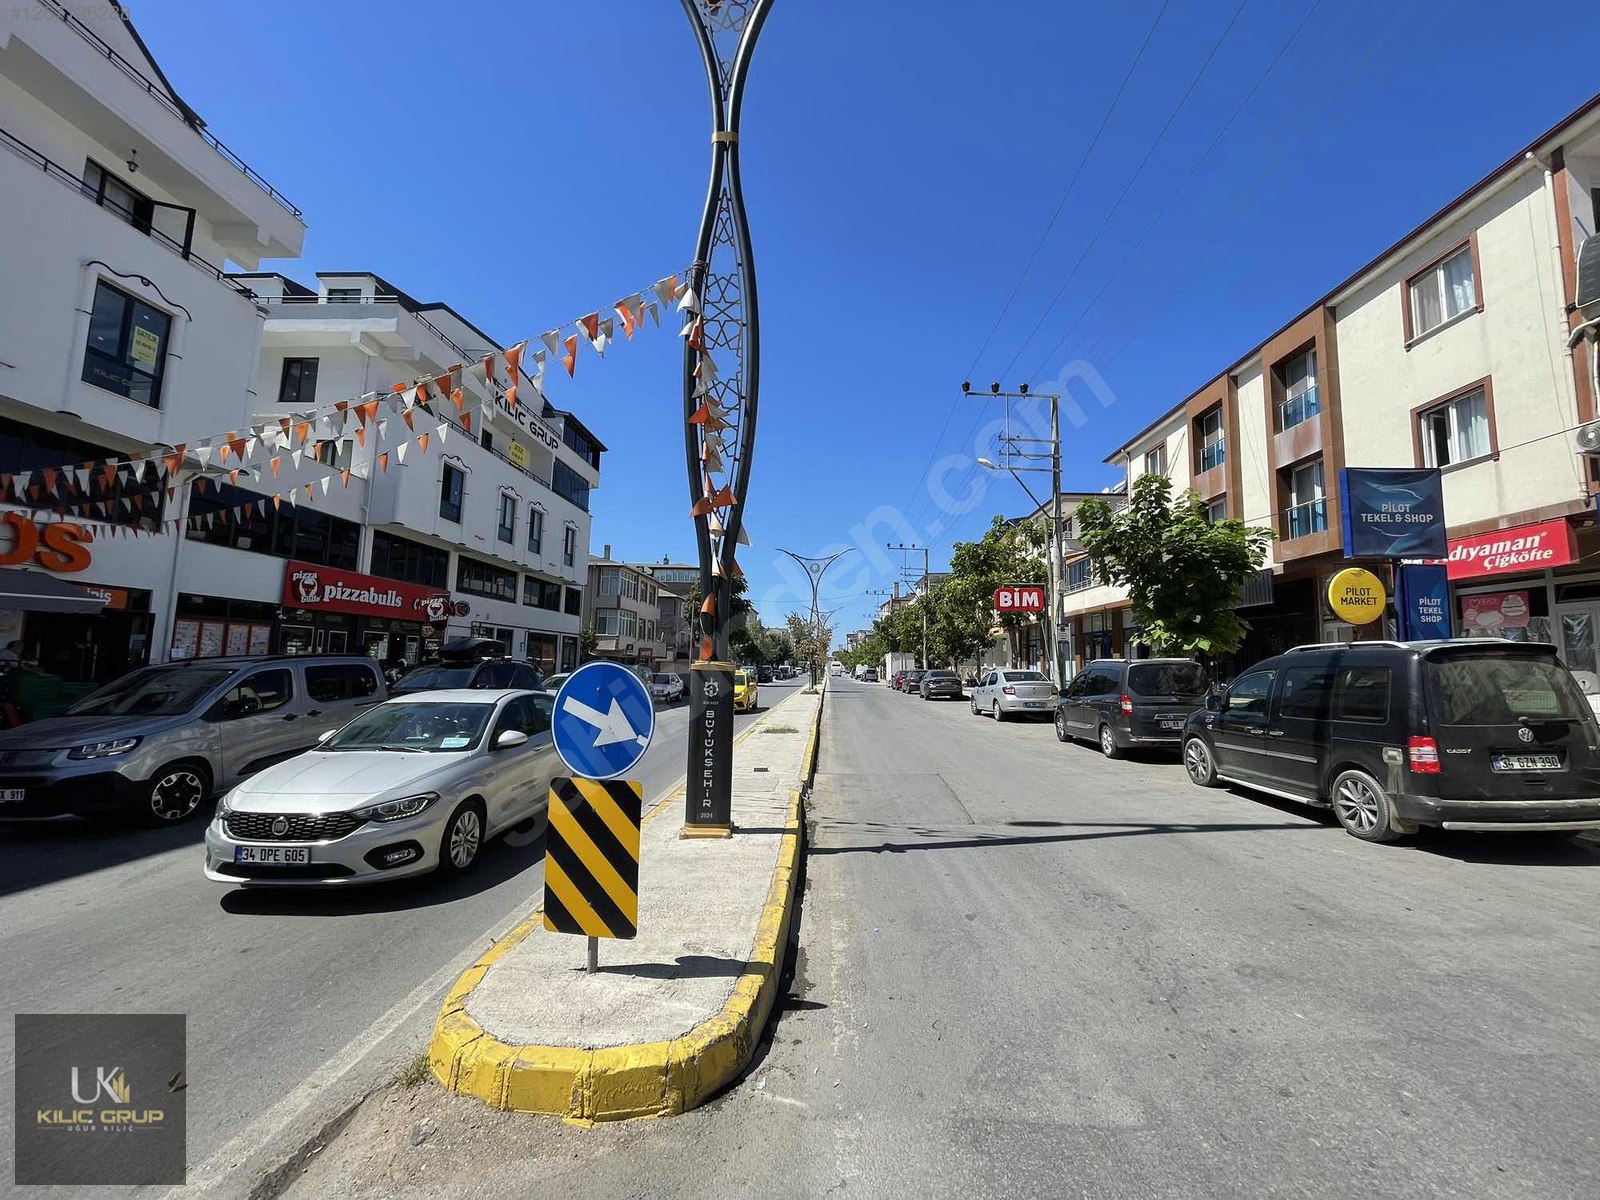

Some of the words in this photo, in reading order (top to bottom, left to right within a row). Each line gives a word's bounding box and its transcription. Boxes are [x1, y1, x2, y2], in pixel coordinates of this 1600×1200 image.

[529, 420, 560, 450] GRUP
[1381, 501, 1411, 513] PİLOT
[1361, 513, 1394, 523] TEKEL
[1395, 513, 1403, 523] &
[1404, 514, 1434, 523] SHOP
[1448, 533, 1542, 562] dıyaman
[1483, 548, 1553, 570] Çiğköfte
[323, 581, 403, 608] pizzabulls
[999, 587, 1040, 607] BİM
[1340, 596, 1378, 606] MARKET
[1419, 596, 1442, 606] PİLOT
[1418, 606, 1443, 614] TEKEL
[1420, 615, 1442, 623] SHOP
[1539, 756, 1559, 767] 390
[242, 848, 256, 861] 34
[260, 849, 281, 861] DPE
[284, 850, 305, 862] 605
